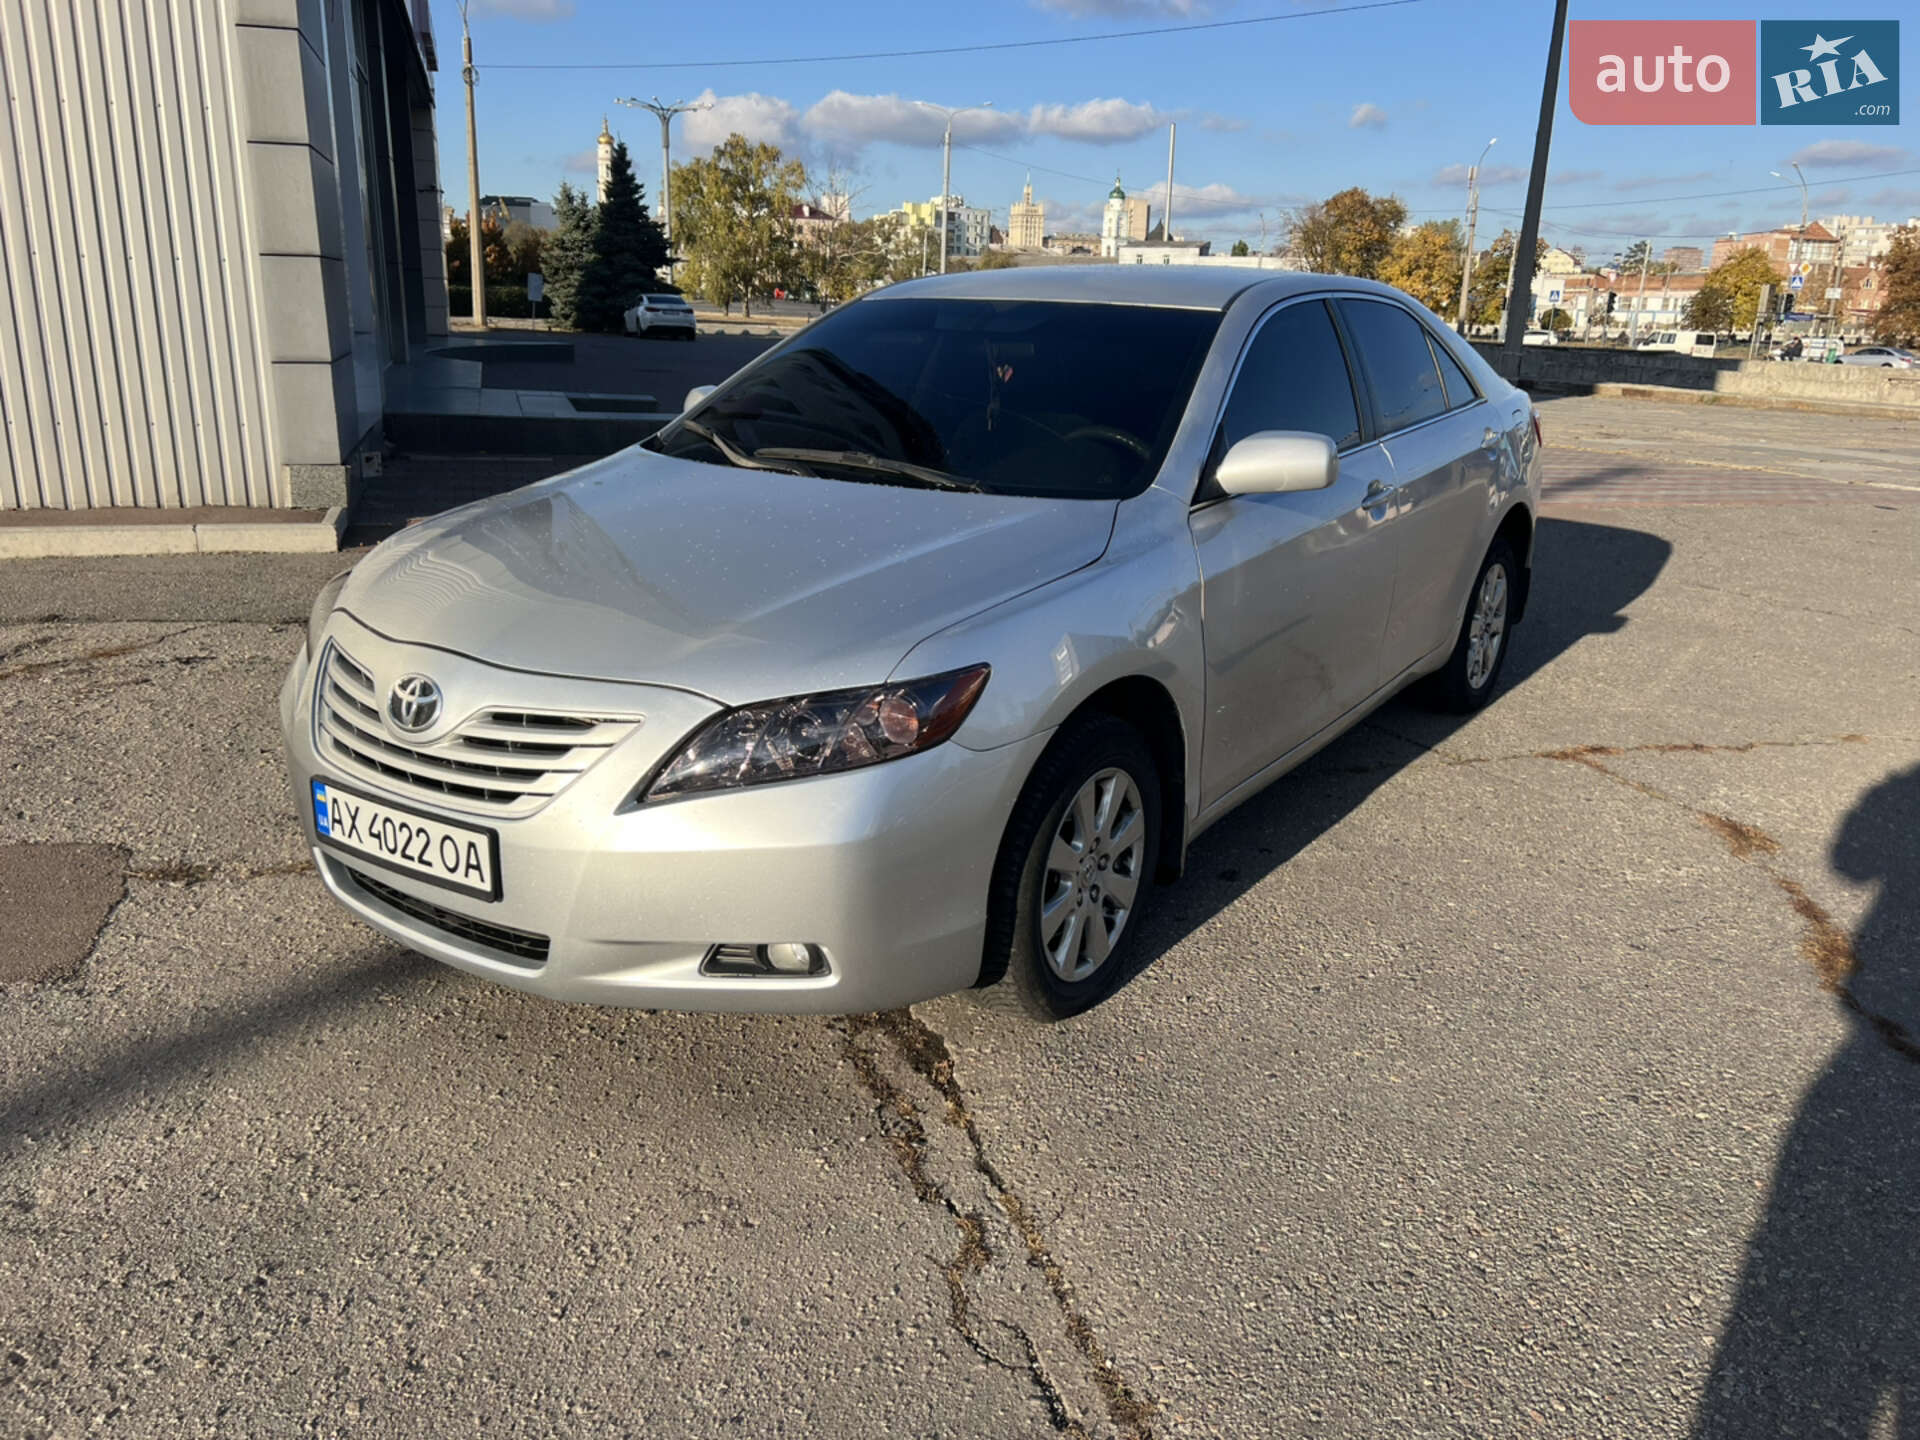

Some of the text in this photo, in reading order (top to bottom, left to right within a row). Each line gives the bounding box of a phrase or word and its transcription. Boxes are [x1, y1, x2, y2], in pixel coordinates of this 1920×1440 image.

[331, 797, 486, 884] AX 4022 OA
